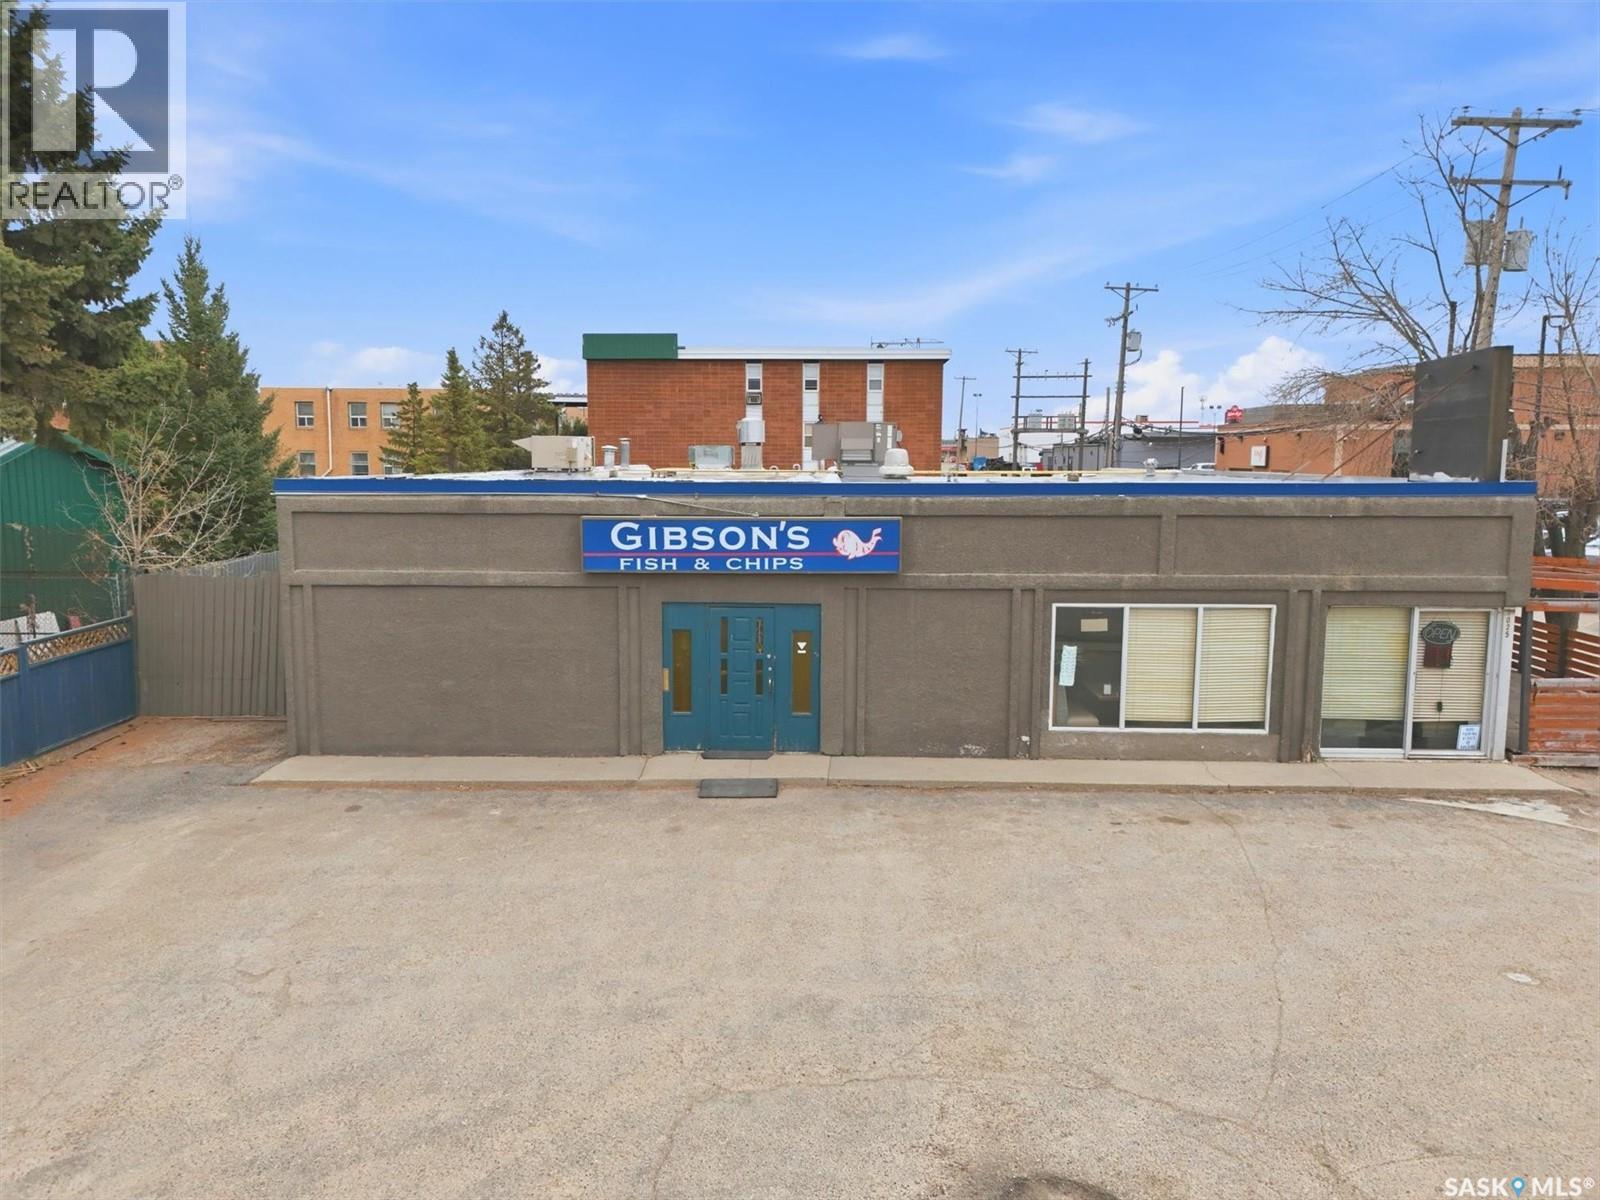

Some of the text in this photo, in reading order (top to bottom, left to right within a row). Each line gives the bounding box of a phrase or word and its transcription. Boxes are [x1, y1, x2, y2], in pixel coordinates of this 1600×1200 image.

[610, 520, 810, 551] GIBSON'S
[619, 557, 804, 571] FISH & CHIPS
[1424, 627, 1457, 641] OPEN
